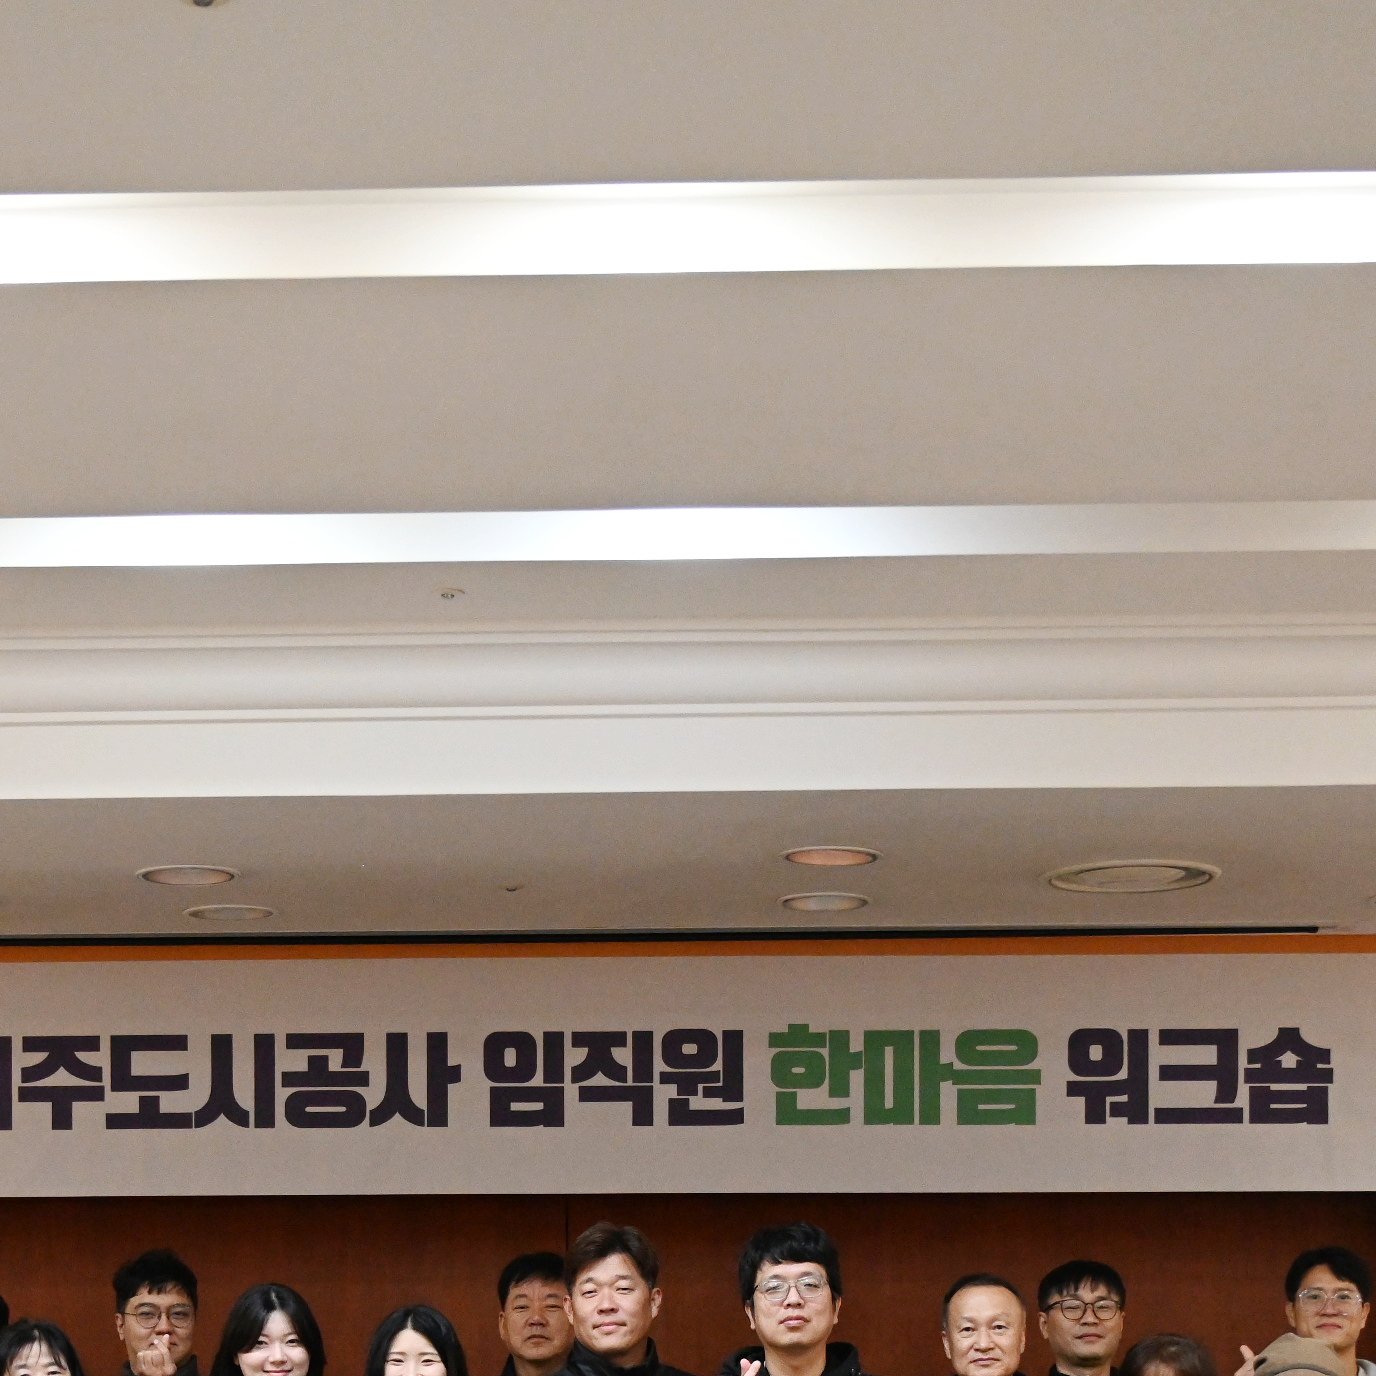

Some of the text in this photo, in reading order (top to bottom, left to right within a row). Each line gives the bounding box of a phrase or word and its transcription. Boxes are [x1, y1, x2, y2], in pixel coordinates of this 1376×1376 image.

[483, 1029, 743, 1127] 임직원
[768, 1023, 1041, 1125] 한마음
[1066, 1027, 1333, 1125] 워크숍
